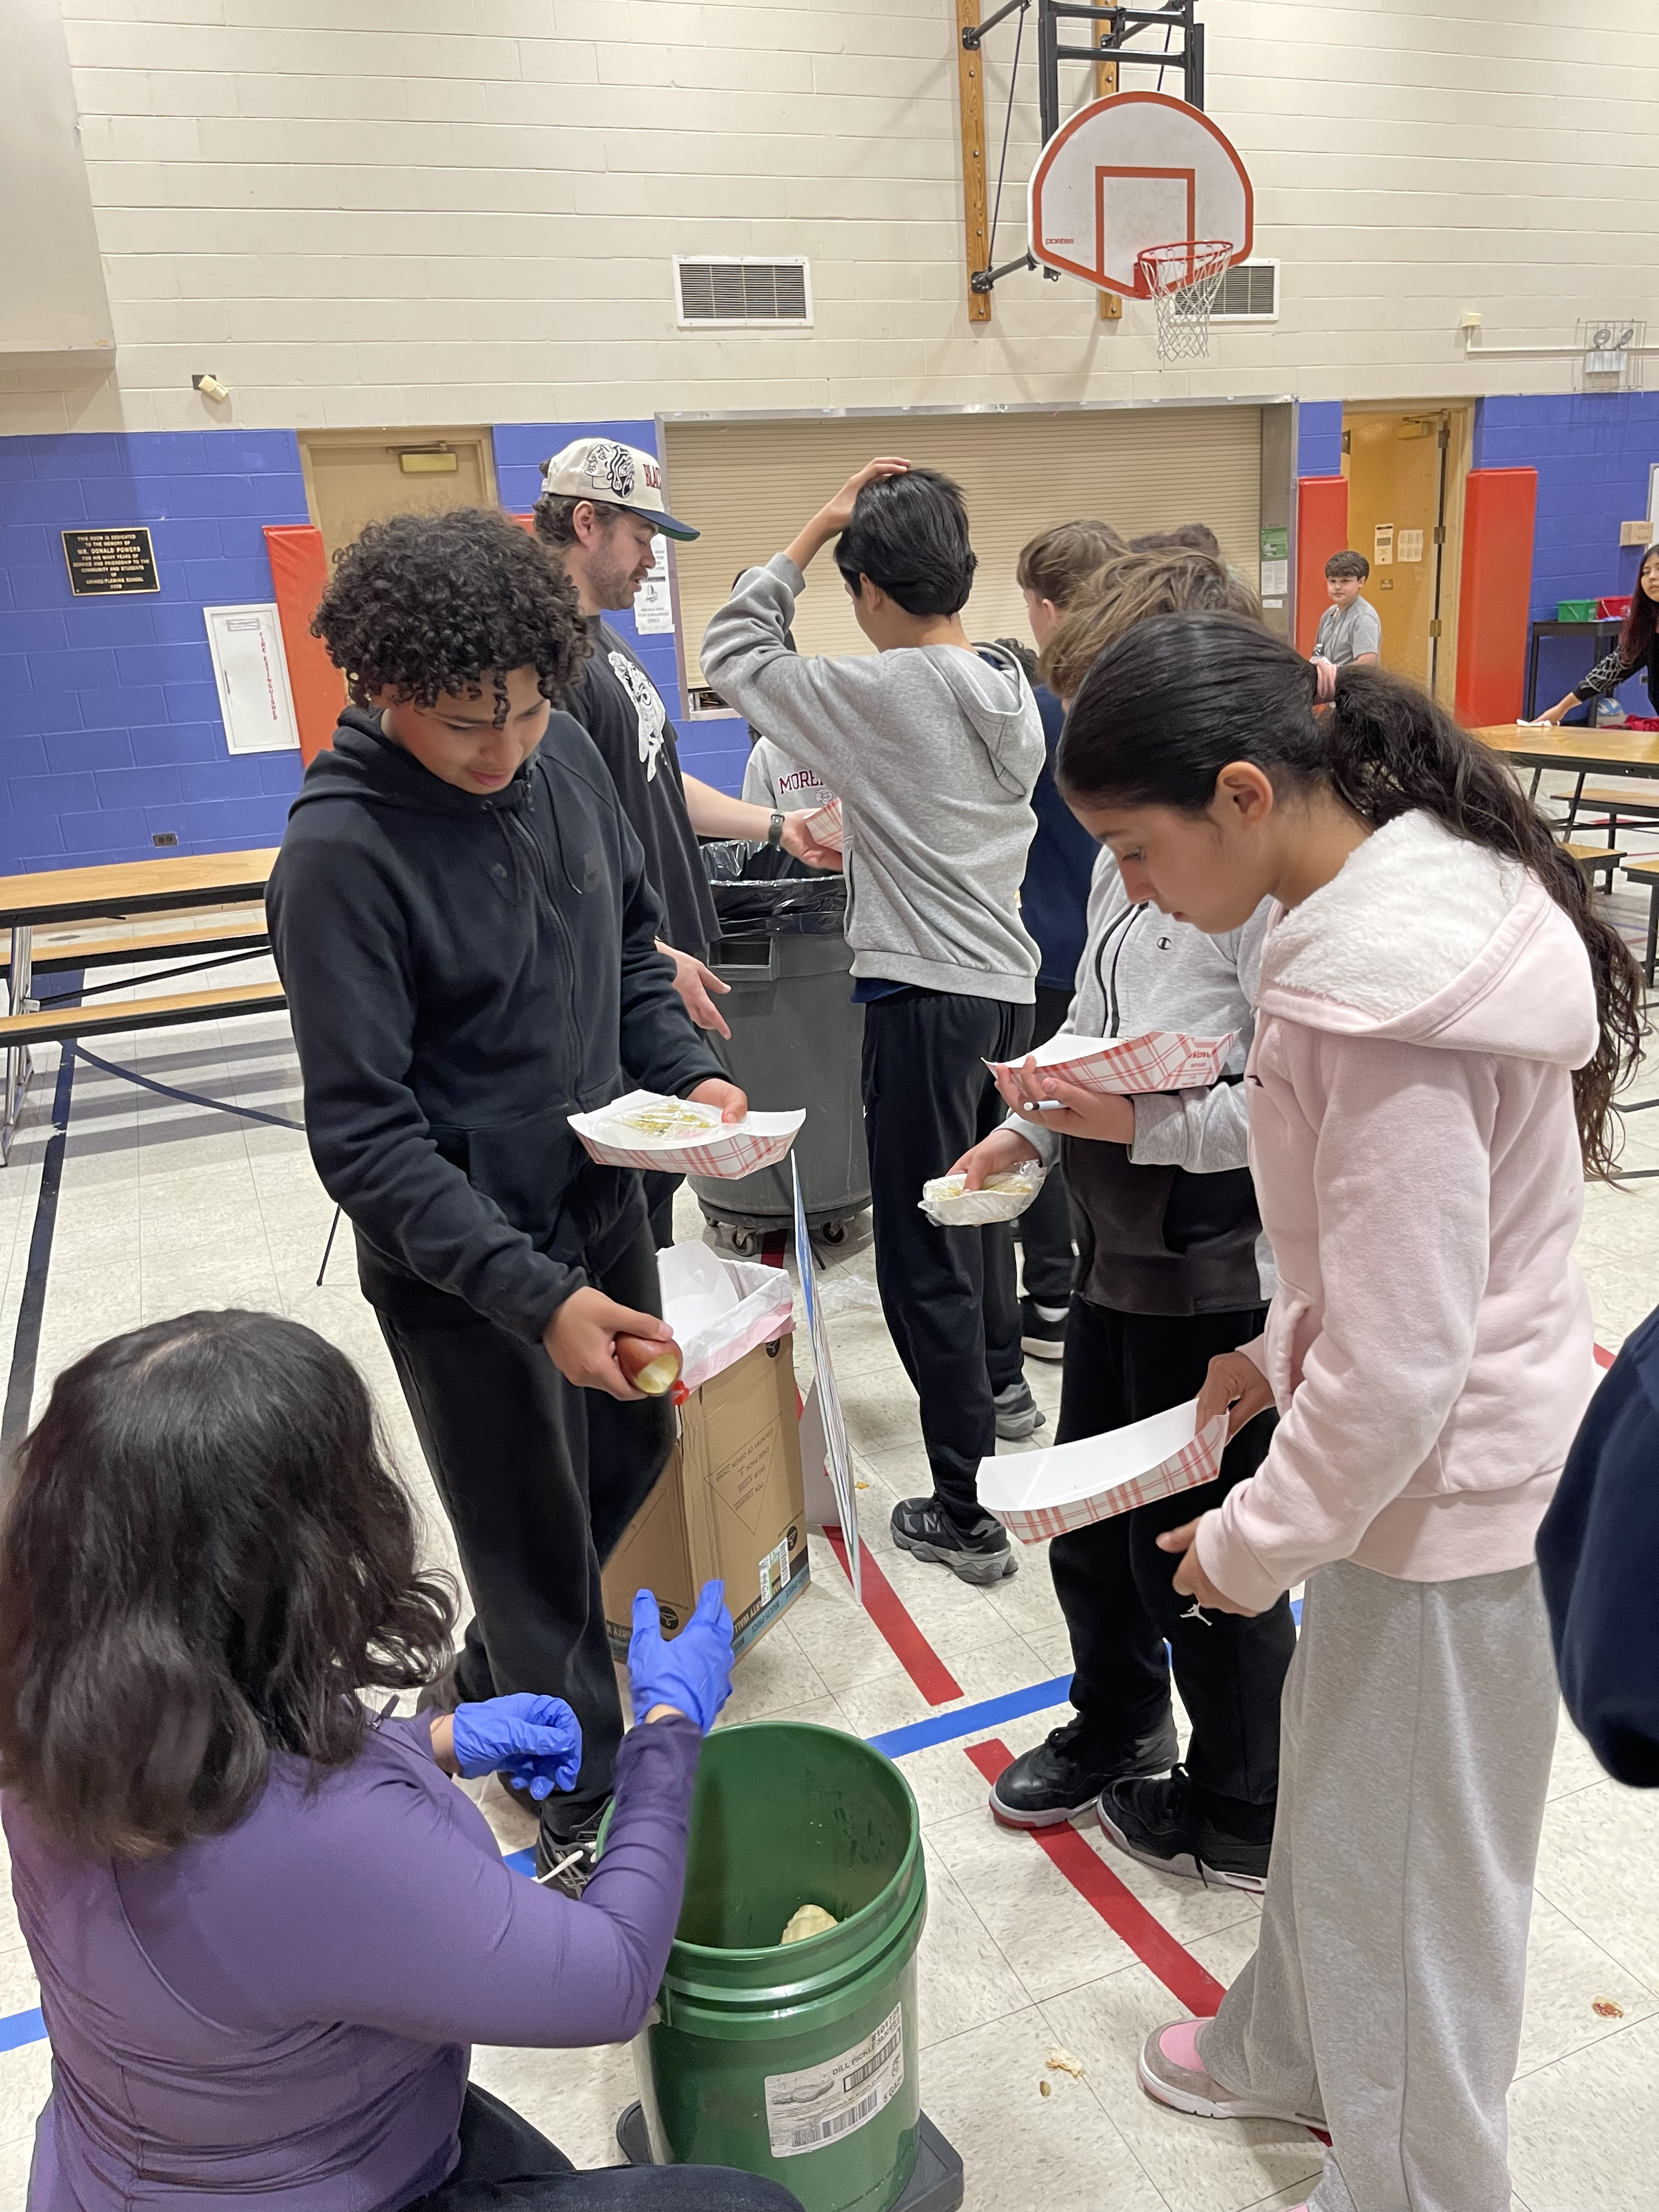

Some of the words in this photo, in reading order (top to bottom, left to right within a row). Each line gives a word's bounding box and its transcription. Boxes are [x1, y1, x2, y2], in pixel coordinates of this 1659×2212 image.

[779, 770, 824, 794] MORE
[754, 1428, 773, 1449] COUNTRY
[731, 1451, 747, 1469] ORIGIN
[747, 1446, 754, 1455] OF
[758, 1446, 770, 1458] CASE
[734, 1613, 749, 1633] WALL
[833, 2063, 850, 2075] DILL
[851, 2041, 875, 2065] PICKLE
